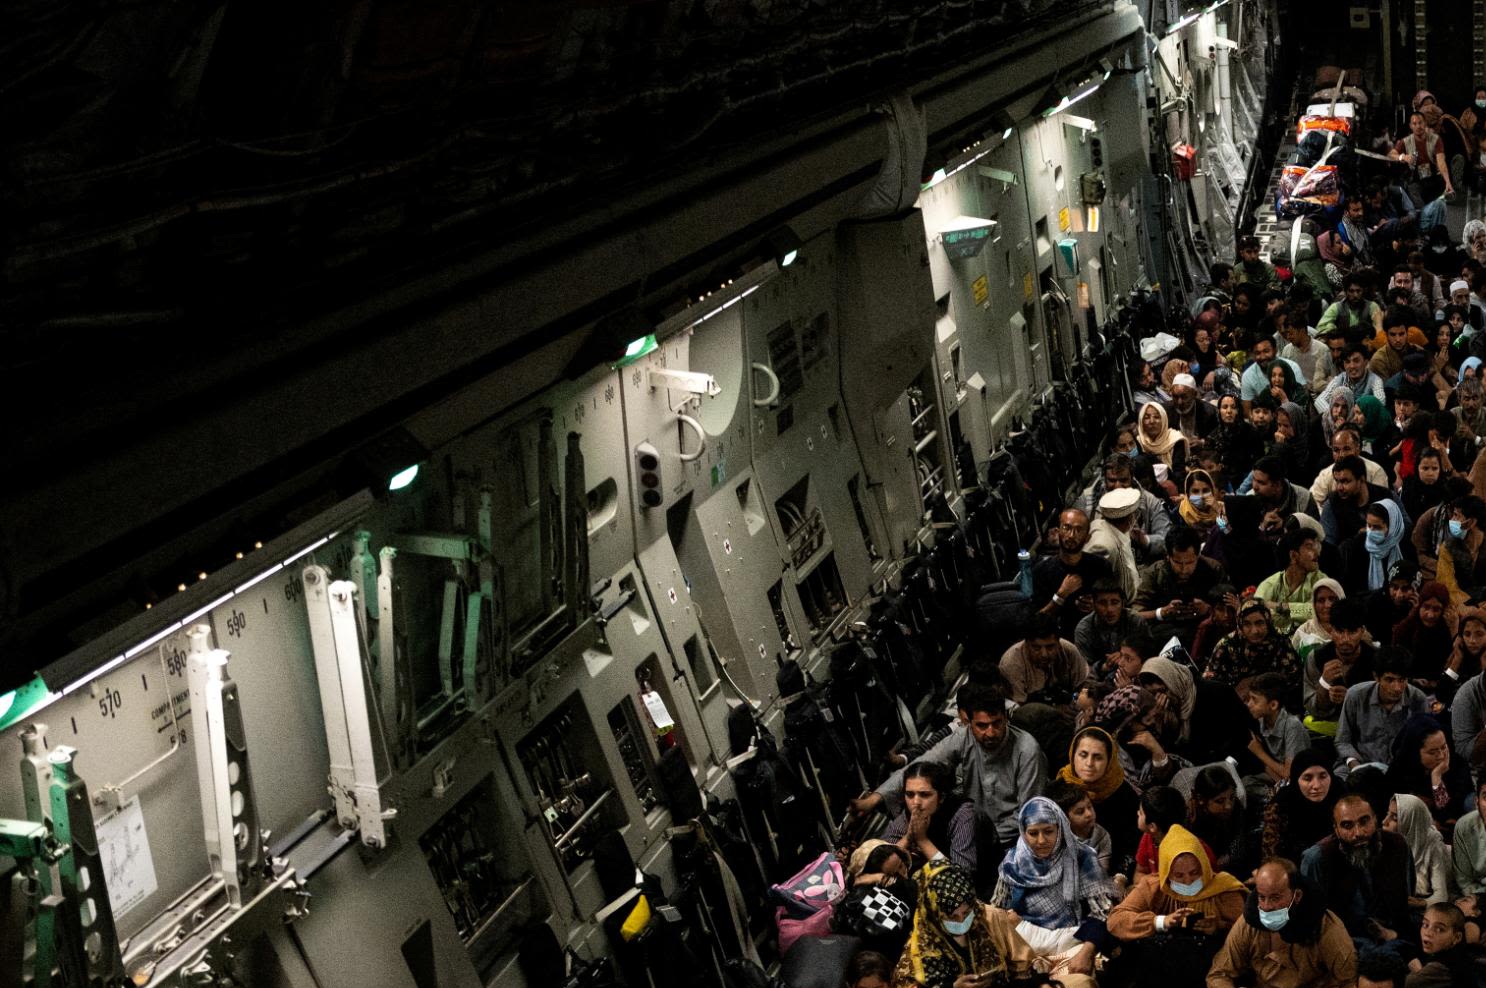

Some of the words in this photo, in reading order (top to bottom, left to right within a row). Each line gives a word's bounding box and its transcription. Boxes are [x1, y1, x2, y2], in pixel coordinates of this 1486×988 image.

[284, 577, 301, 601] 600
[226, 612, 246, 636] 590
[167, 650, 187, 676] 580
[99, 690, 121, 717] 570
